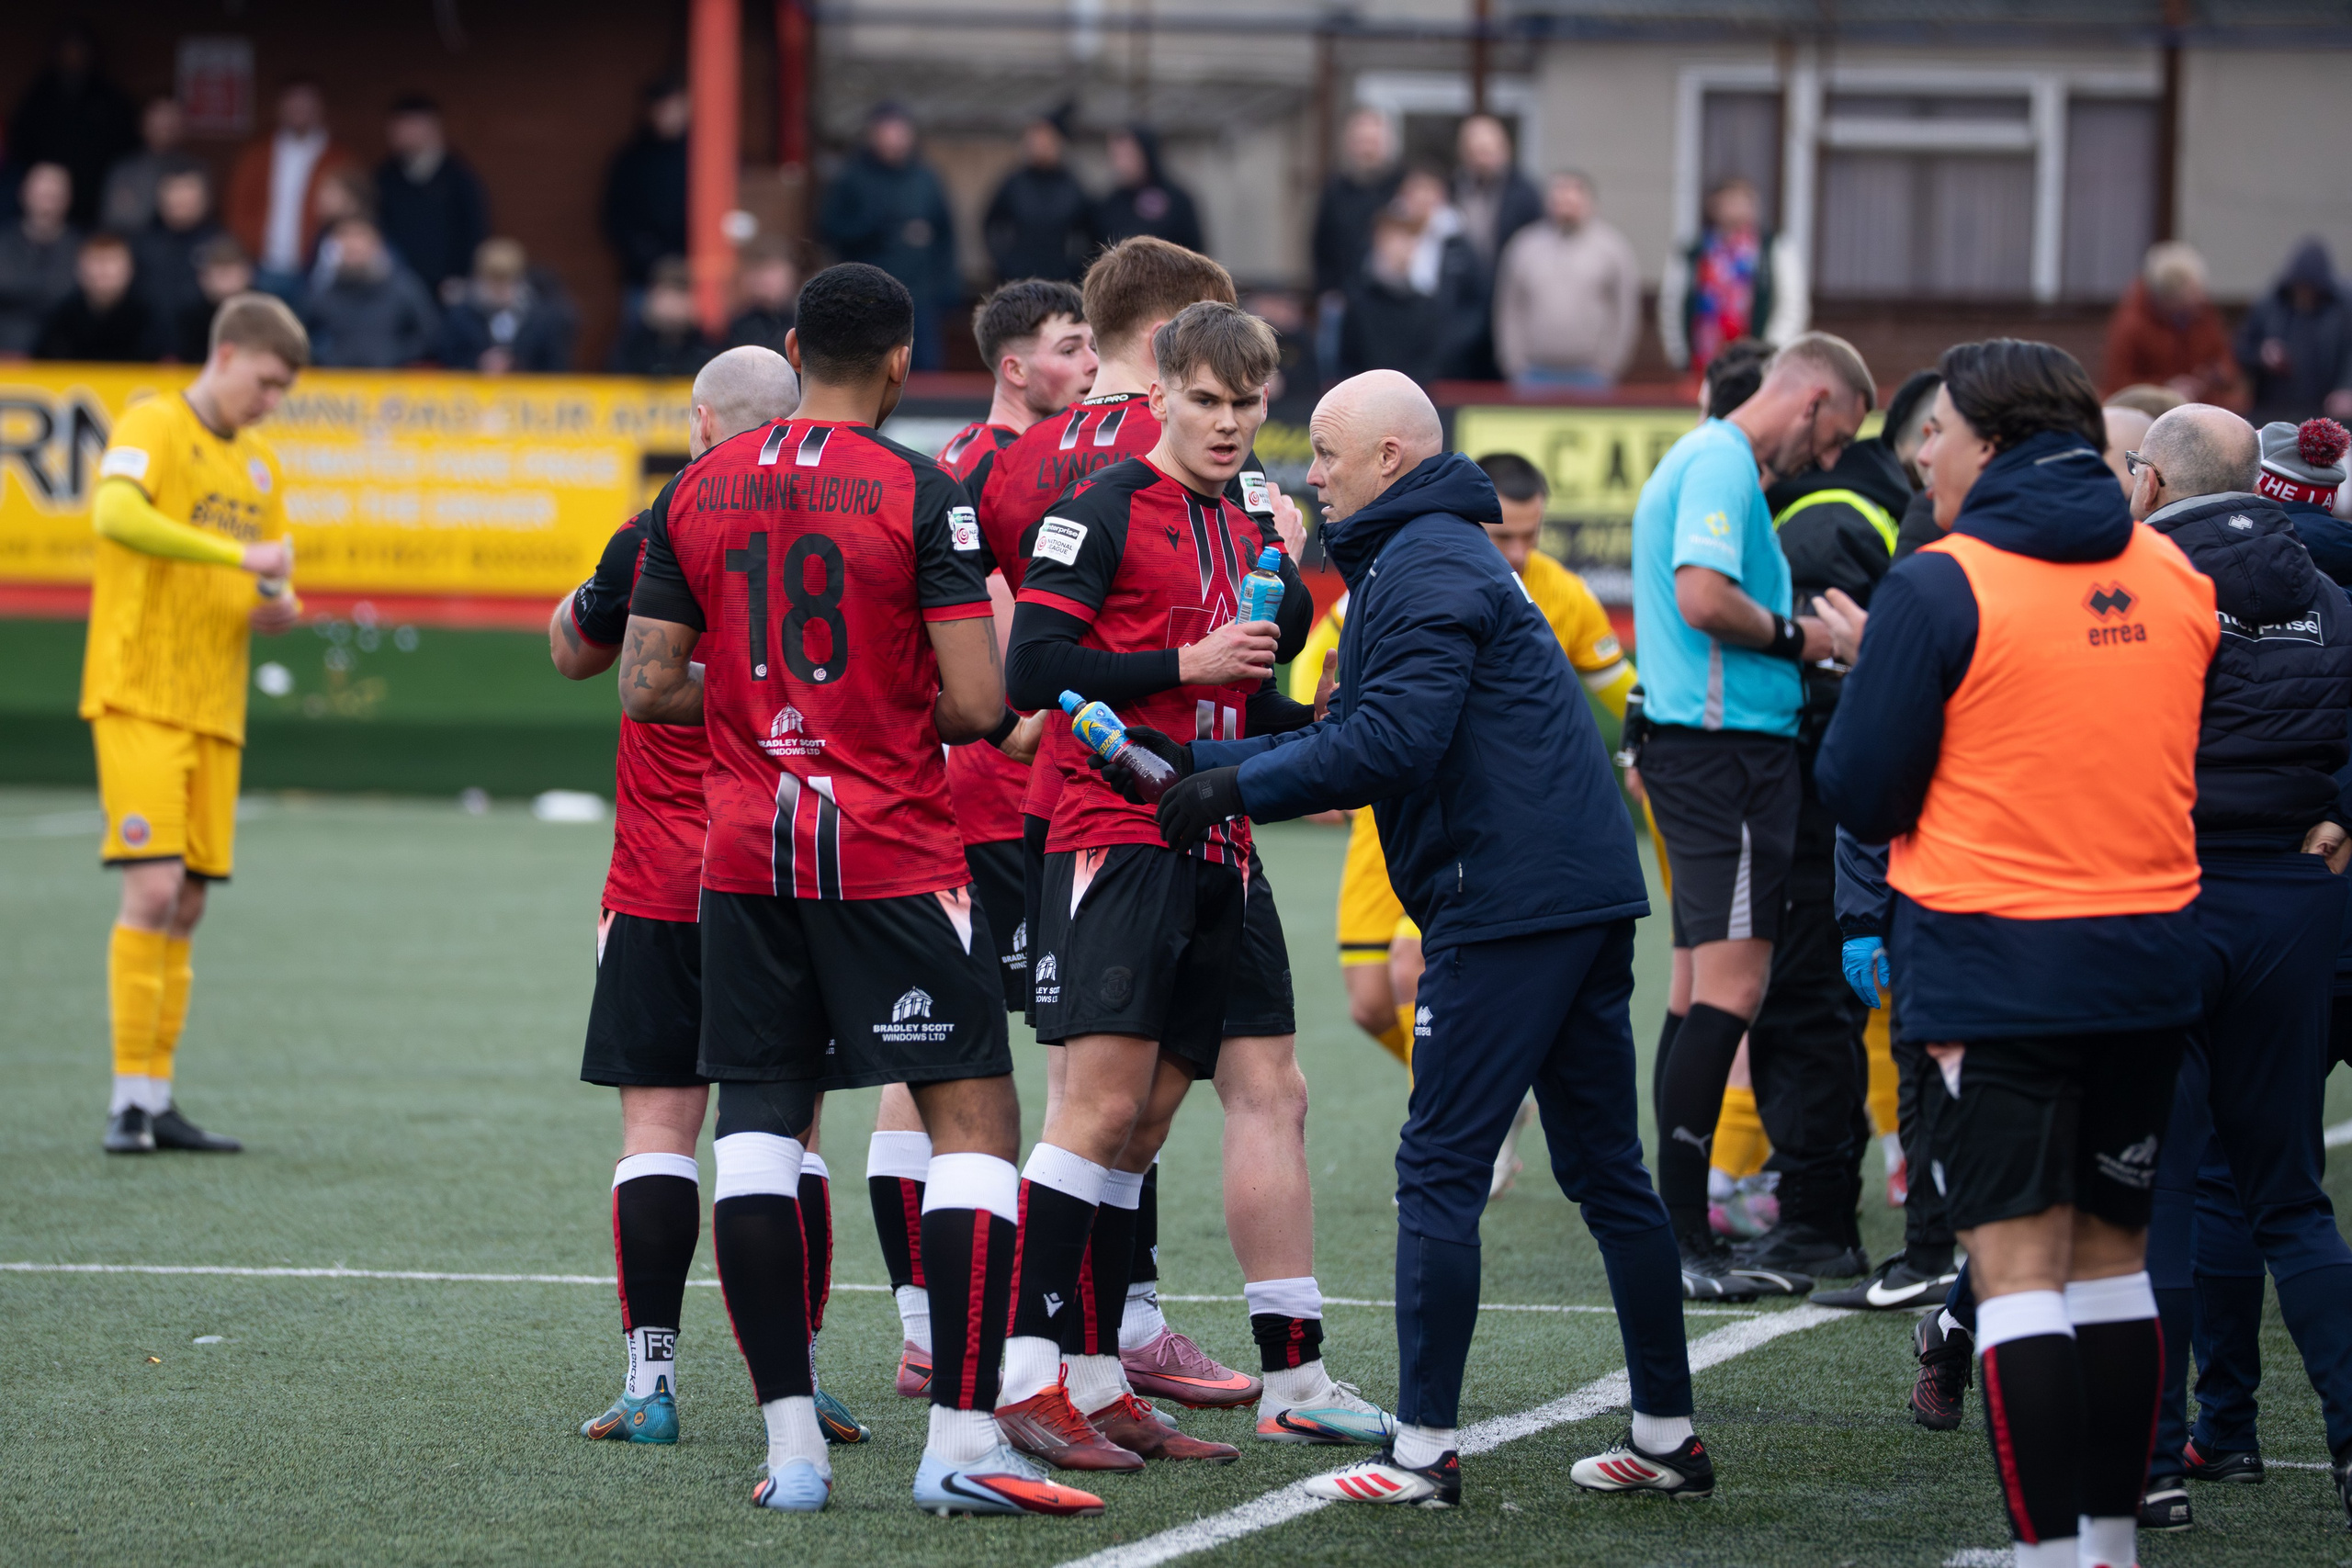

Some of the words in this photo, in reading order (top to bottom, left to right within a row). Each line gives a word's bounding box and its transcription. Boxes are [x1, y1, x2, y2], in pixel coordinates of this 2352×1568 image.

[1104, 394, 1129, 403] PRO
[696, 473, 883, 515] CULLINANE-LIBURD
[2256, 469, 2298, 502] THE
[726, 531, 848, 684] 18
[799, 739, 826, 748] SCOTT
[873, 1024, 920, 1033] BRADLEY
[922, 1023, 955, 1032] SCOTT
[882, 1032, 927, 1042] WINDOWS
[928, 1032, 945, 1042] LTD
[648, 1333, 674, 1359] FS
